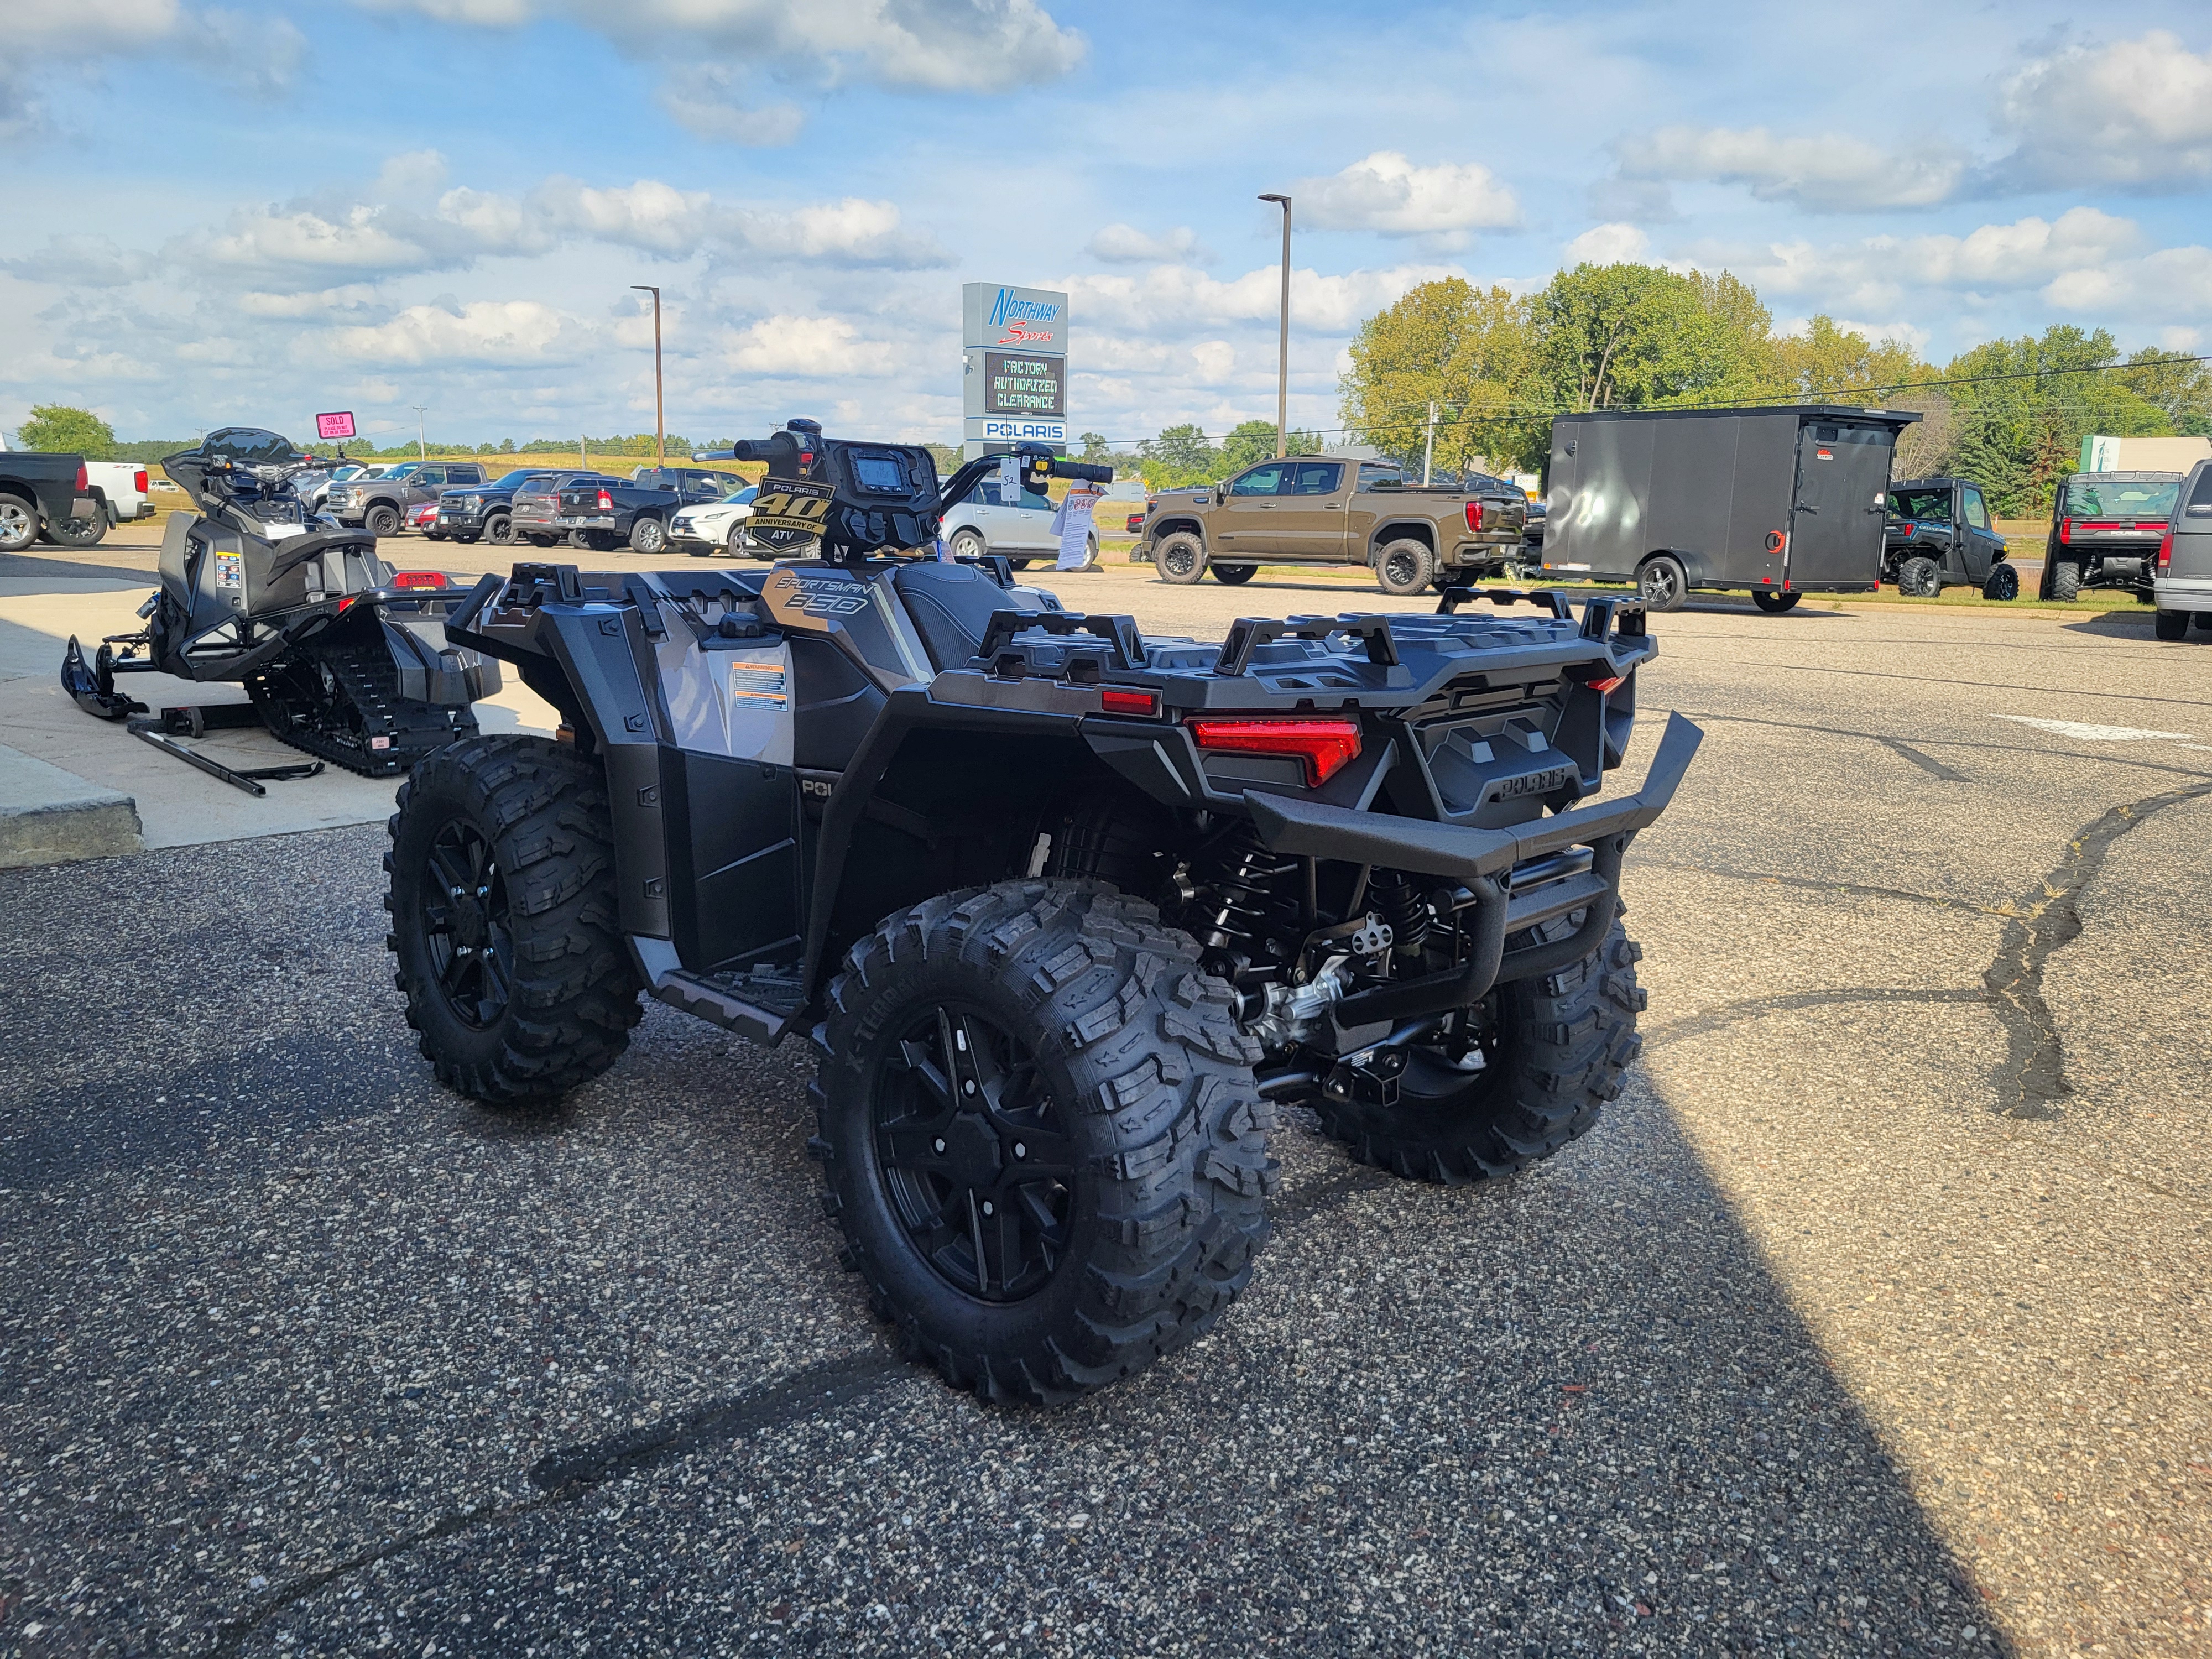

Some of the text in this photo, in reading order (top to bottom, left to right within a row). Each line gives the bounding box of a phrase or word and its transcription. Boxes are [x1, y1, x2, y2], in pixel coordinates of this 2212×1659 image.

[988, 288, 1061, 327] NORTHWAY
[997, 321, 1053, 345] Sports
[1004, 359, 1047, 376] FACTORY
[994, 376, 1058, 393] AUTHORIZED
[997, 393, 1055, 409] CLEARANCE
[326, 416, 343, 425] SOLD
[987, 423, 1063, 439] POLARIS
[1002, 475, 1017, 486] 52
[773, 484, 820, 495] POLARIS
[755, 518, 806, 529] ANNIVERSARY
[771, 530, 794, 540] ATV
[776, 578, 874, 594] SPORTSMAN
[782, 592, 868, 615] 850
[1502, 768, 1564, 797] POLARIS
